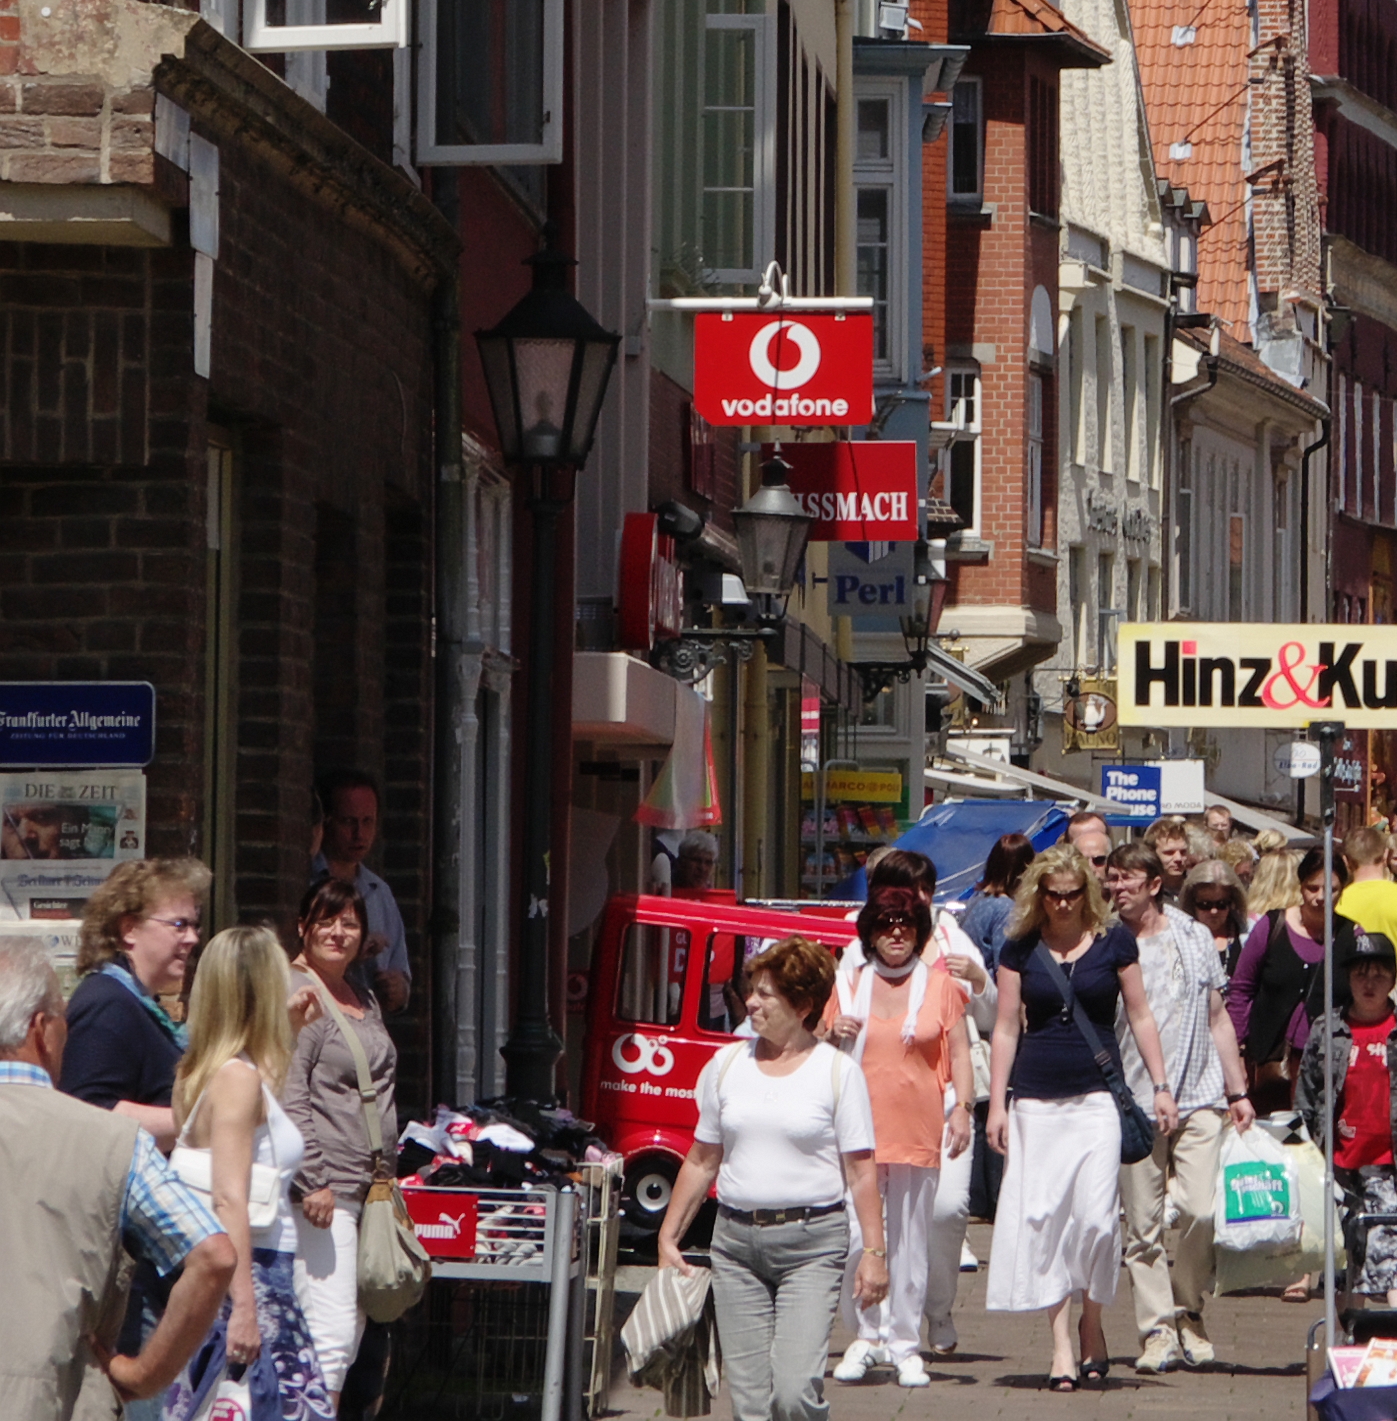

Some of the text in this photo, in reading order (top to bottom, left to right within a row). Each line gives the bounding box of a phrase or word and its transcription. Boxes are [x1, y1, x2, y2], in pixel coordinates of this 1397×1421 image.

[721, 393, 849, 417] vodafone
[835, 575, 905, 604] Perl
[68, 710, 141, 731] Allgemeine
[1107, 771, 1139, 786] The
[25, 783, 117, 799] DIE ZEIT
[1106, 786, 1157, 801] Phone
[61, 823, 78, 834] Ein
[601, 1079, 637, 1093] make
[640, 1081, 662, 1096] the
[414, 1223, 455, 1239] PUMA
